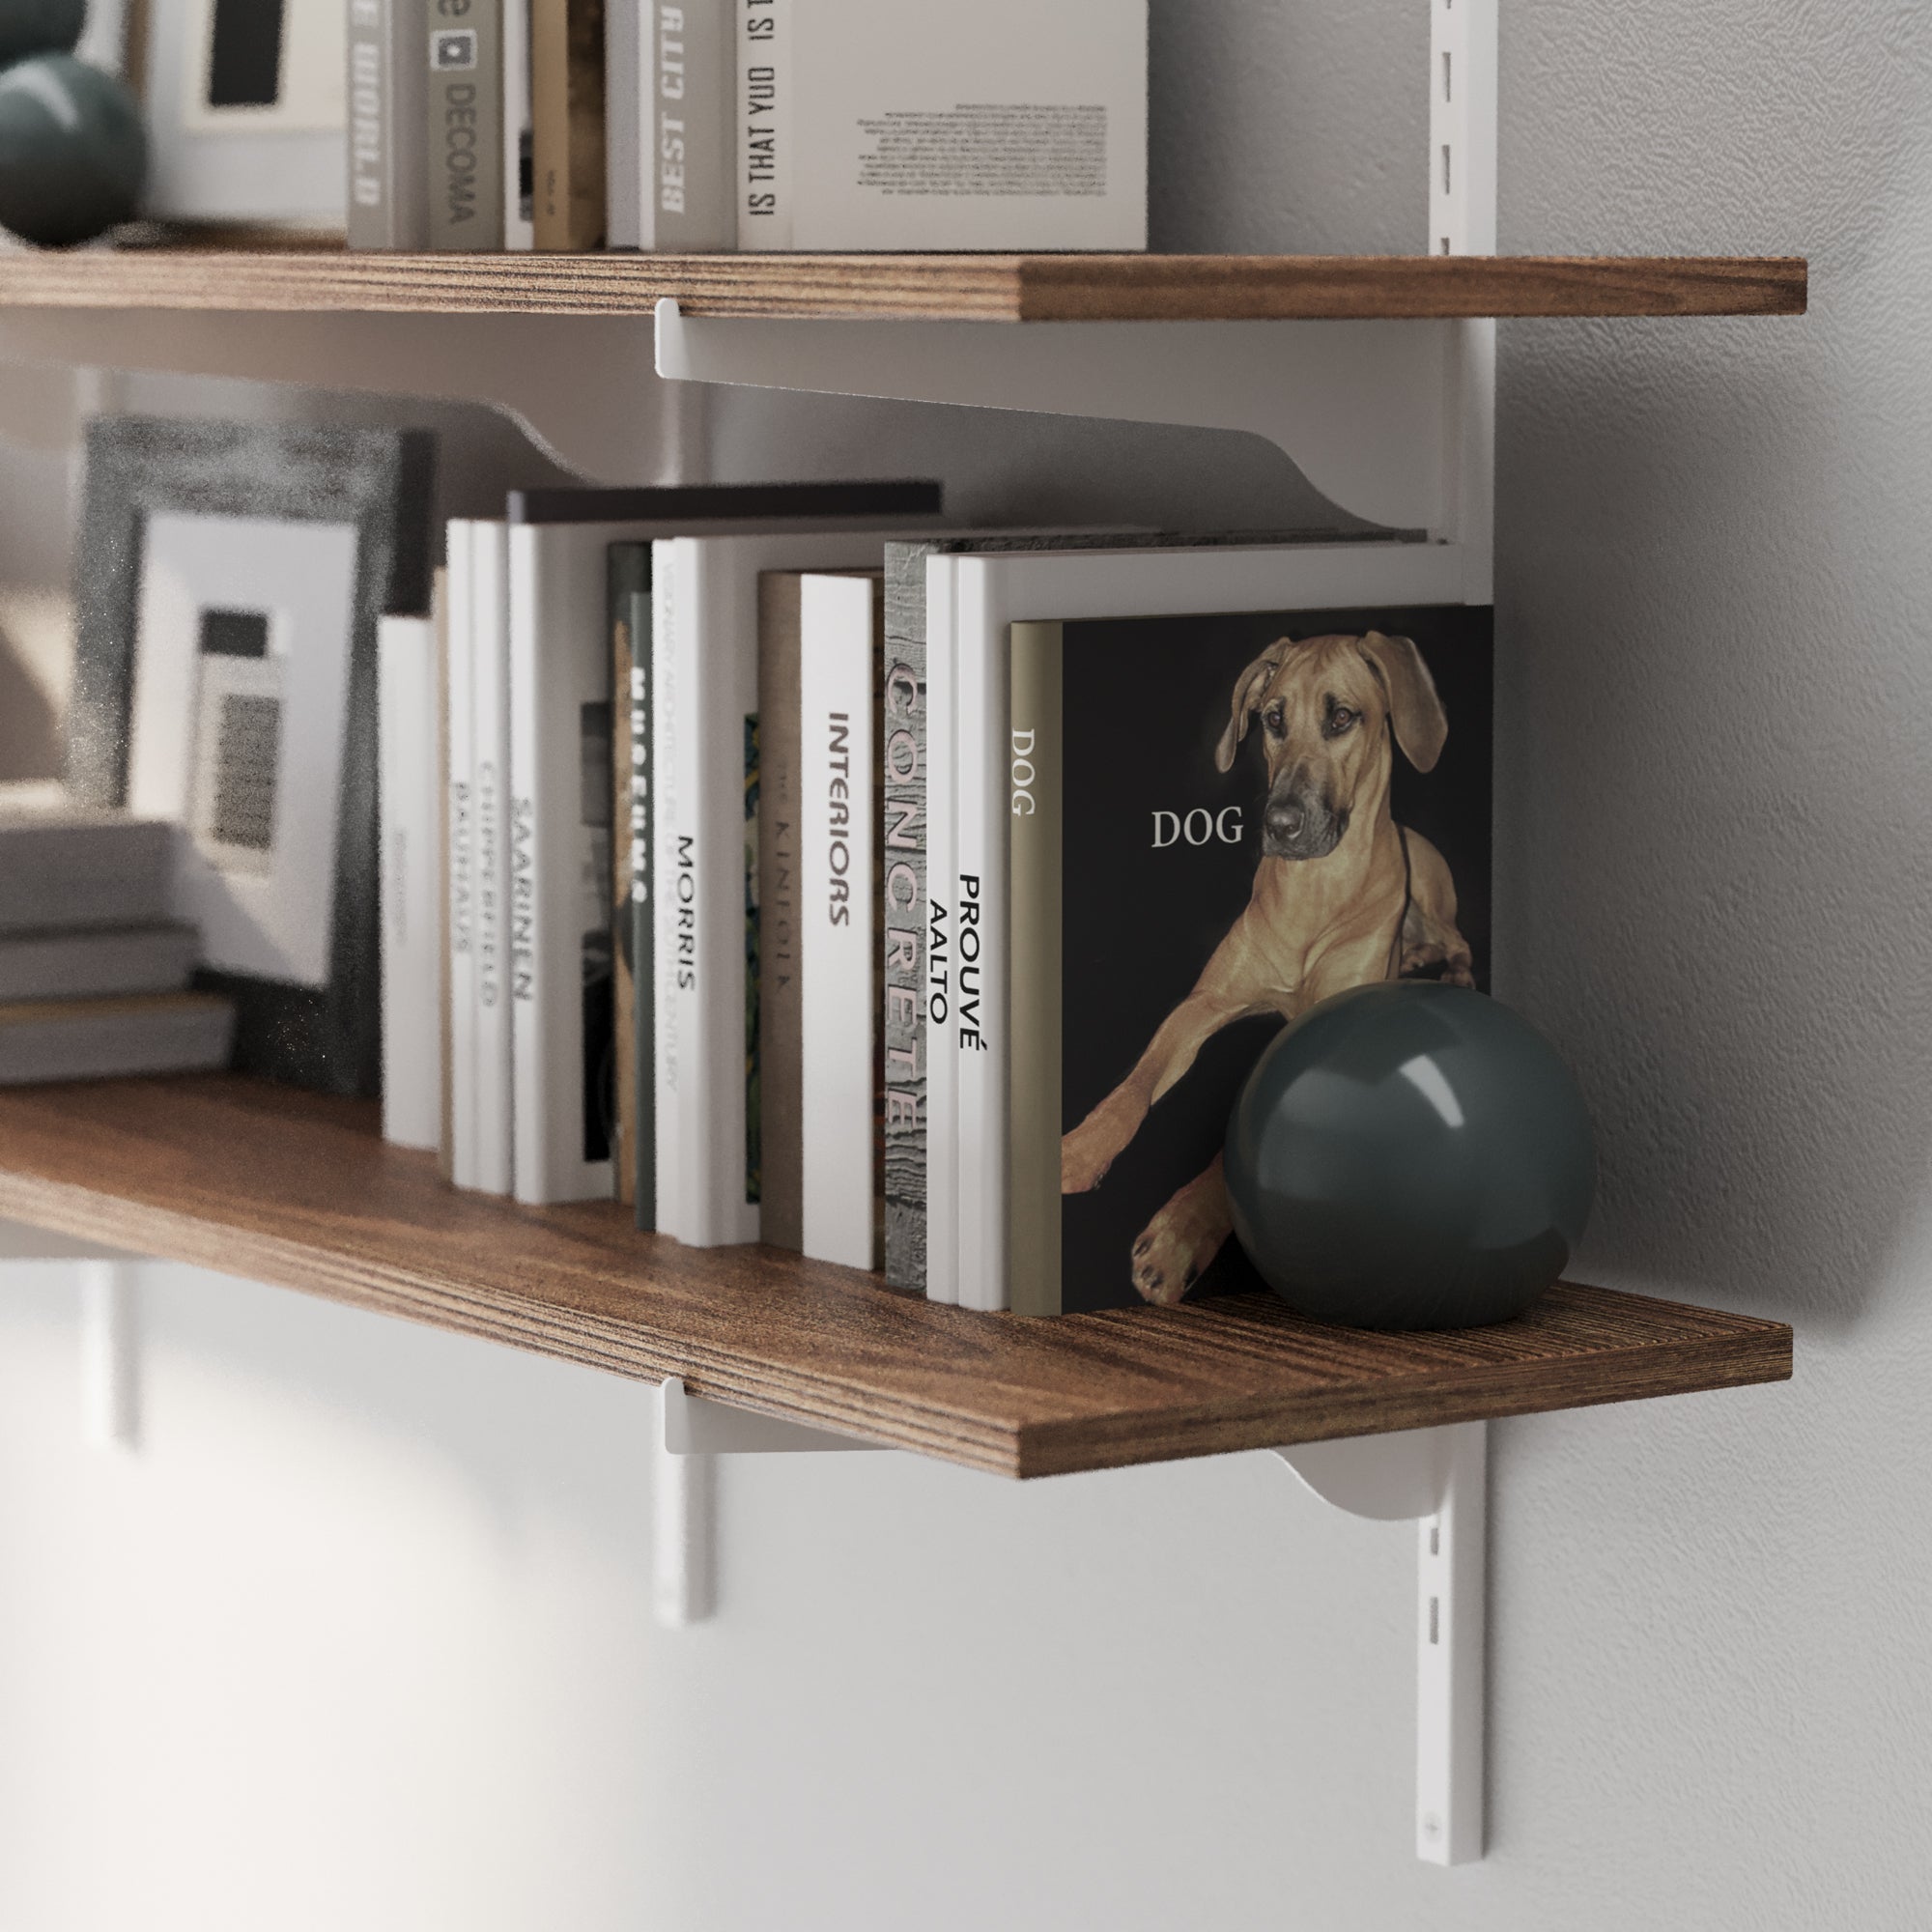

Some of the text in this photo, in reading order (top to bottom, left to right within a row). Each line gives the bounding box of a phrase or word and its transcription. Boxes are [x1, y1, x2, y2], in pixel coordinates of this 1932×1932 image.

[747, 17, 774, 41] IS
[445, 83, 476, 226] DECOMA
[661, 6, 685, 214] BEST CITY
[748, 126, 775, 185] THAT
[748, 194, 775, 217] IS
[828, 711, 850, 927] INTERIORS
[1012, 728, 1036, 816] DOG
[1151, 806, 1244, 848] DOG
[512, 797, 534, 1002] SAARINEN
[677, 835, 696, 992] MORRIS
[886, 664, 919, 1128] CONCRETE
[929, 899, 949, 1026] AALTO
[959, 874, 987, 1051] PROUVÉ
